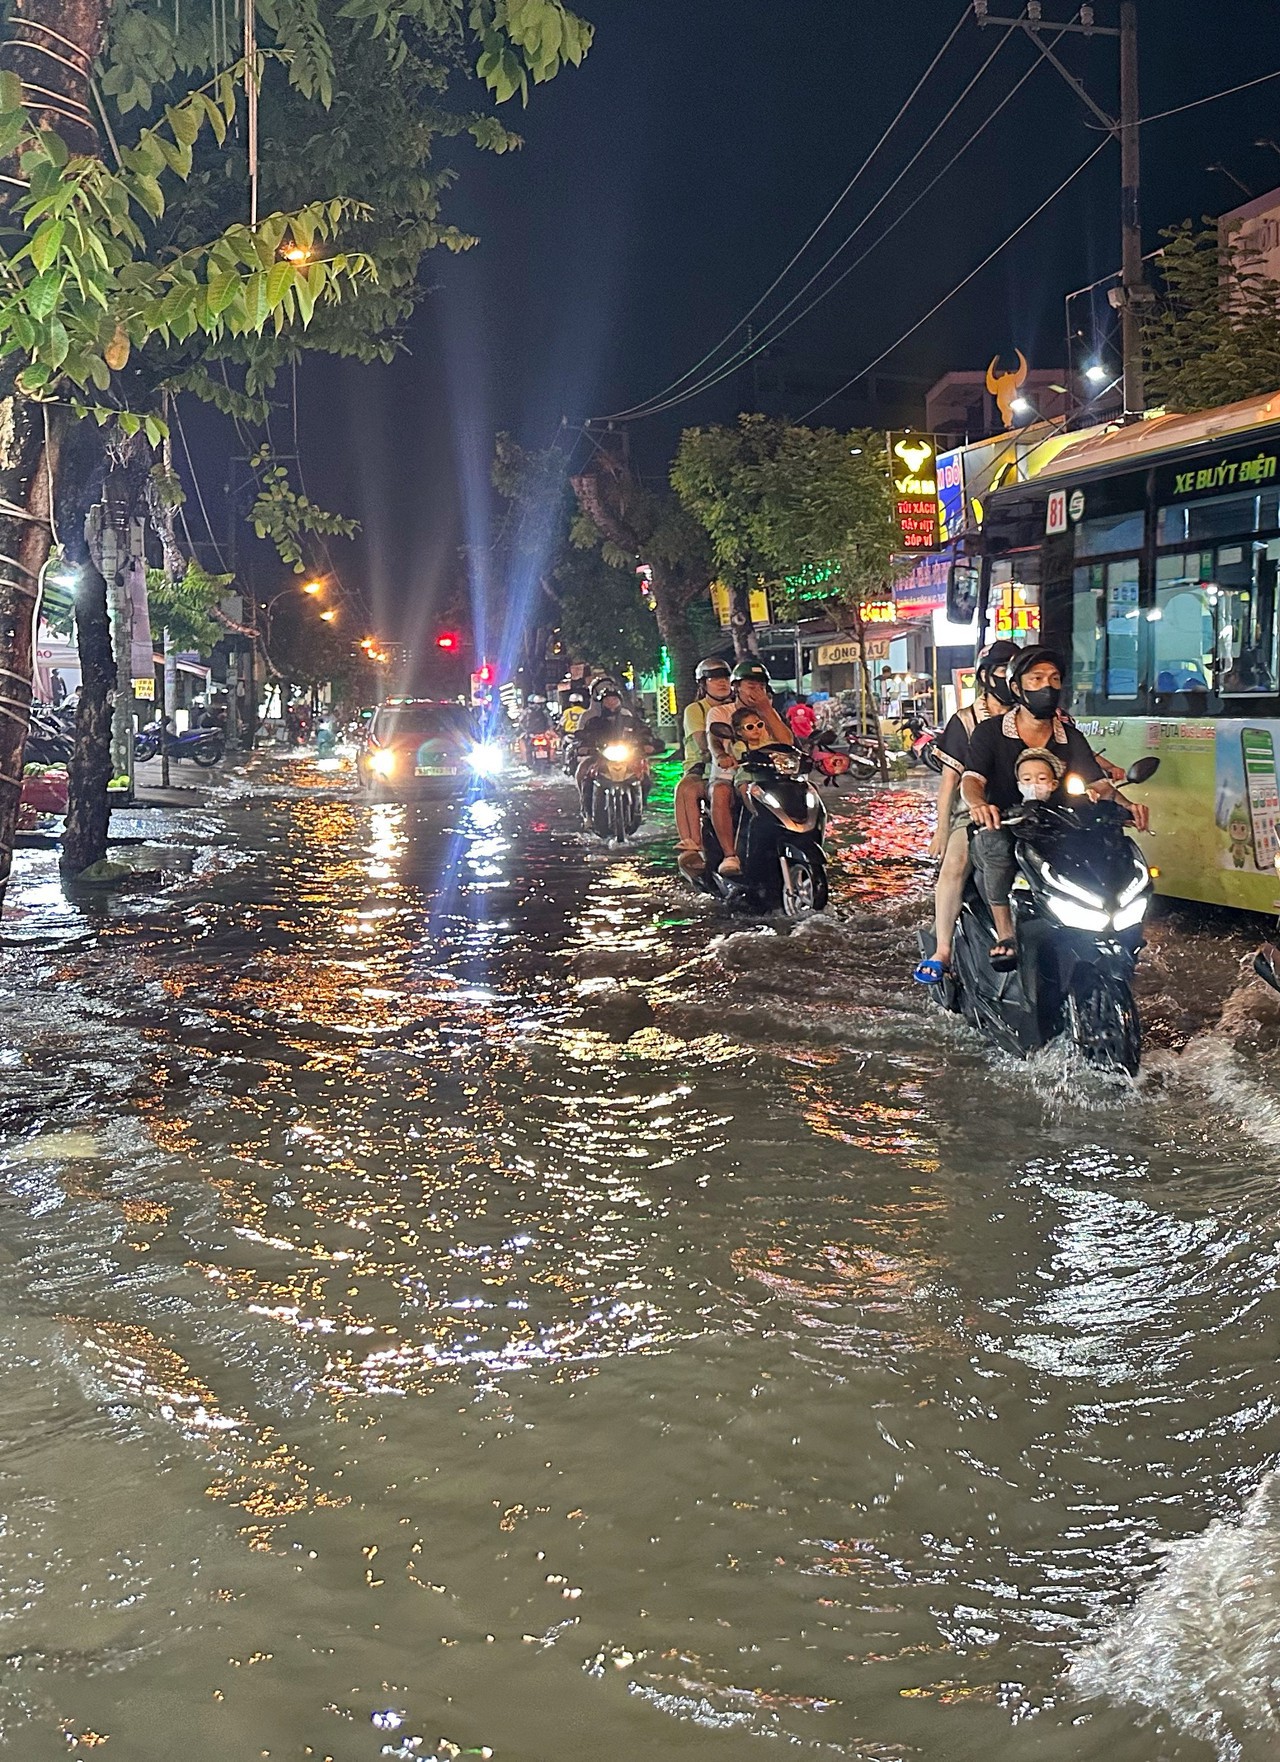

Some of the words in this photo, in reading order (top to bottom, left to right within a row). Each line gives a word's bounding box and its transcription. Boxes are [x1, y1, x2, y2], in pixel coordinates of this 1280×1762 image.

[1173, 472, 1195, 494] XE
[1196, 460, 1238, 490] BUÝT
[1050, 498, 1064, 528] 81
[1160, 722, 1179, 738] FUTA
